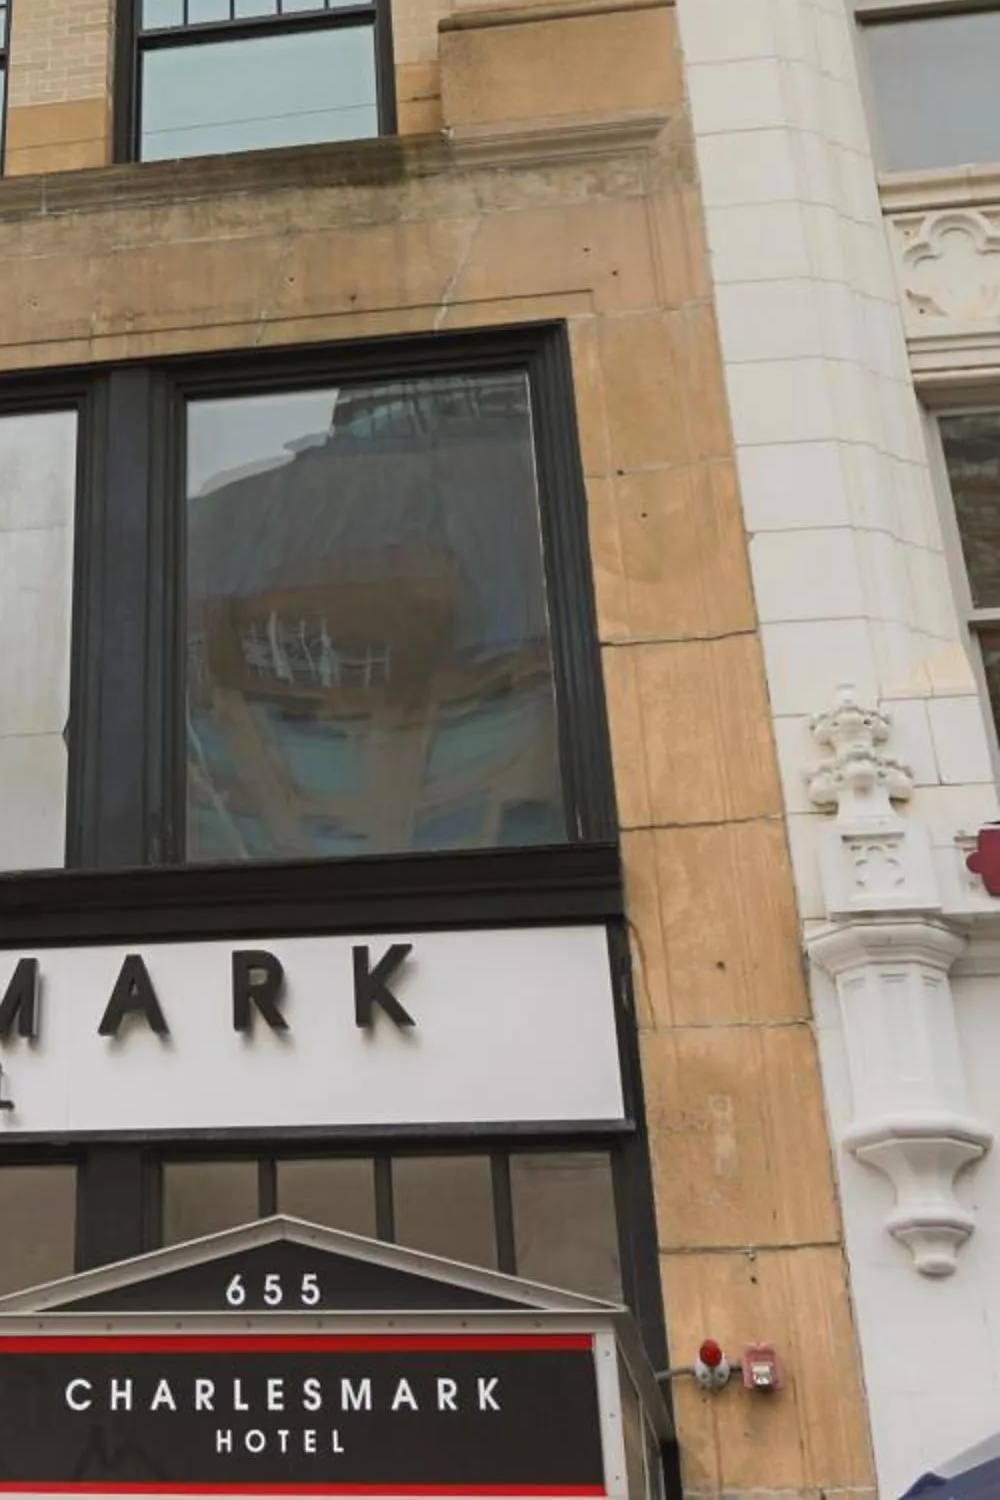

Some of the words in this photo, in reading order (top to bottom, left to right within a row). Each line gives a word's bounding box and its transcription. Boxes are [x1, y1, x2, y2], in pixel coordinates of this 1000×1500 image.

[225, 1273, 322, 1306] 655
[64, 1377, 502, 1412] CHARLESMARK
[216, 1429, 346, 1454] HOTEL
